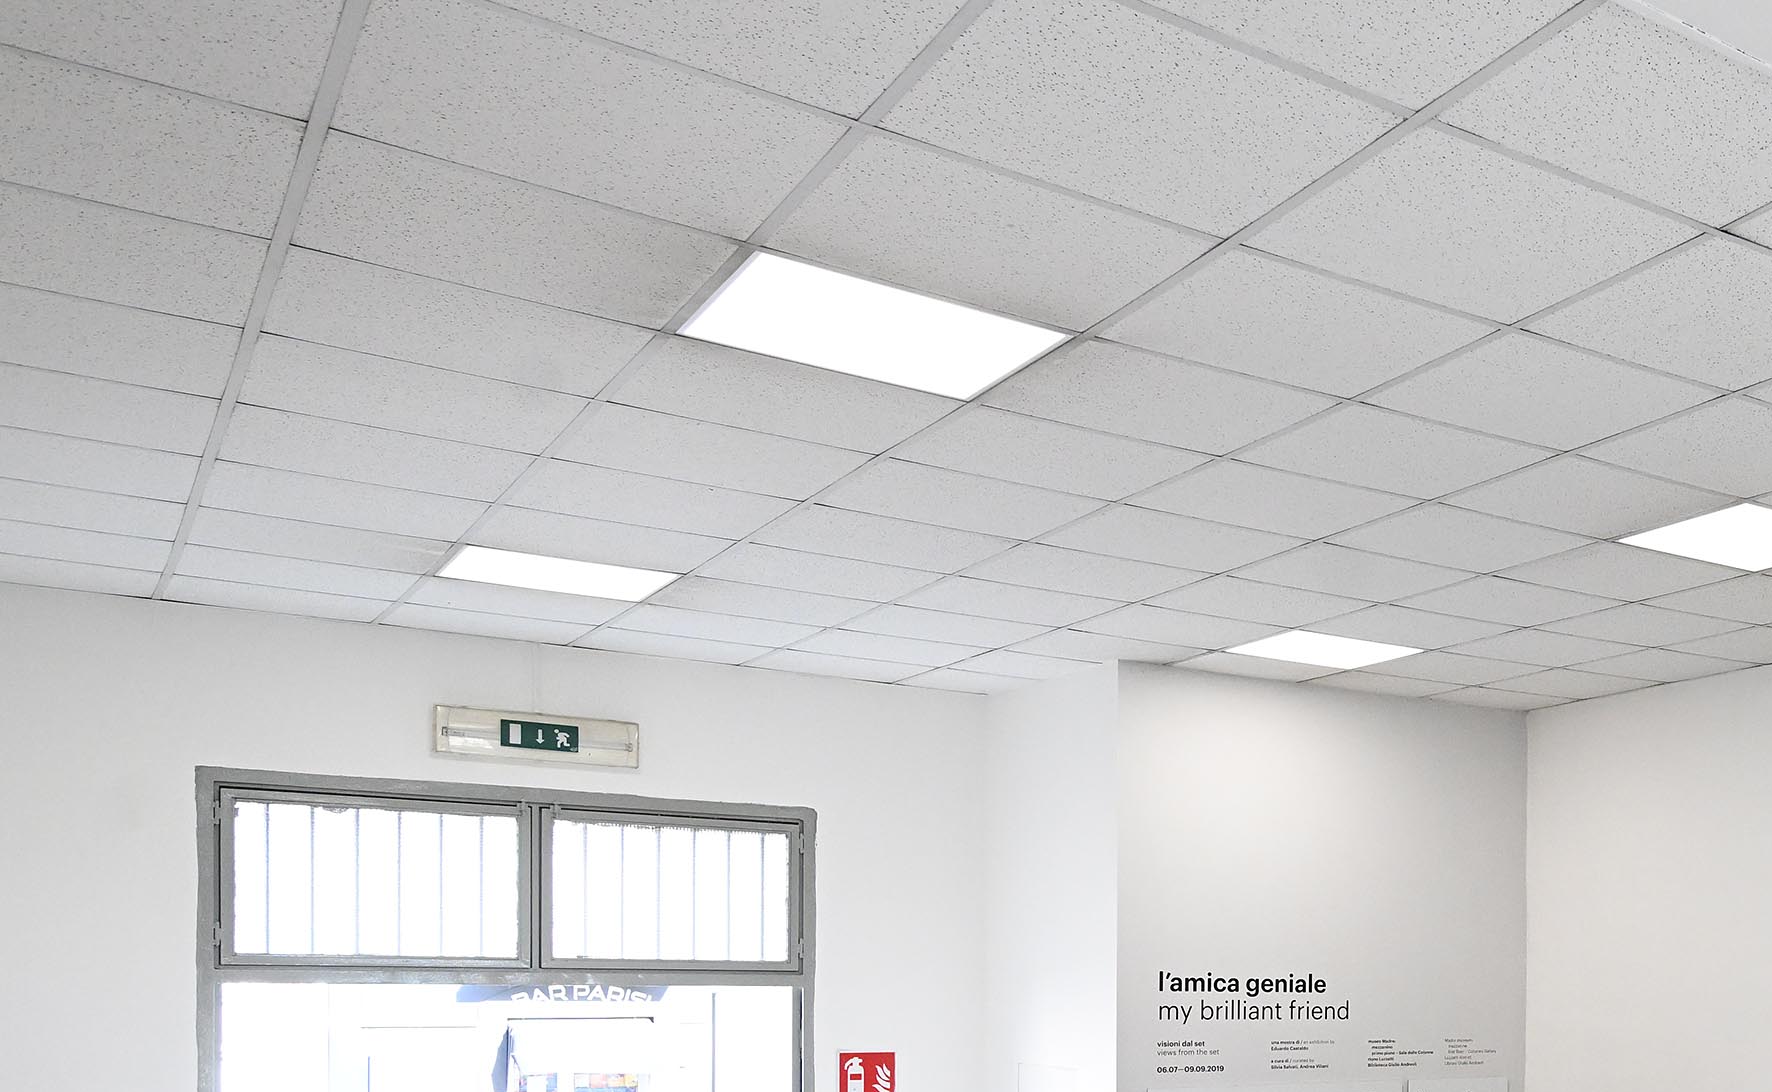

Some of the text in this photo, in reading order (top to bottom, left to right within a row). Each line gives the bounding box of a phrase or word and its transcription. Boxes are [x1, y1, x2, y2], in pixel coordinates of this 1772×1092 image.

[511, 984, 569, 1001] BAR
[1245, 973, 1327, 997] geniale
[1159, 999, 1350, 1025] my brilliant friend
[1156, 1040, 1206, 1048] visioni dal set
[1178, 1048, 1195, 1056] from
[1196, 1048, 1208, 1056] the
